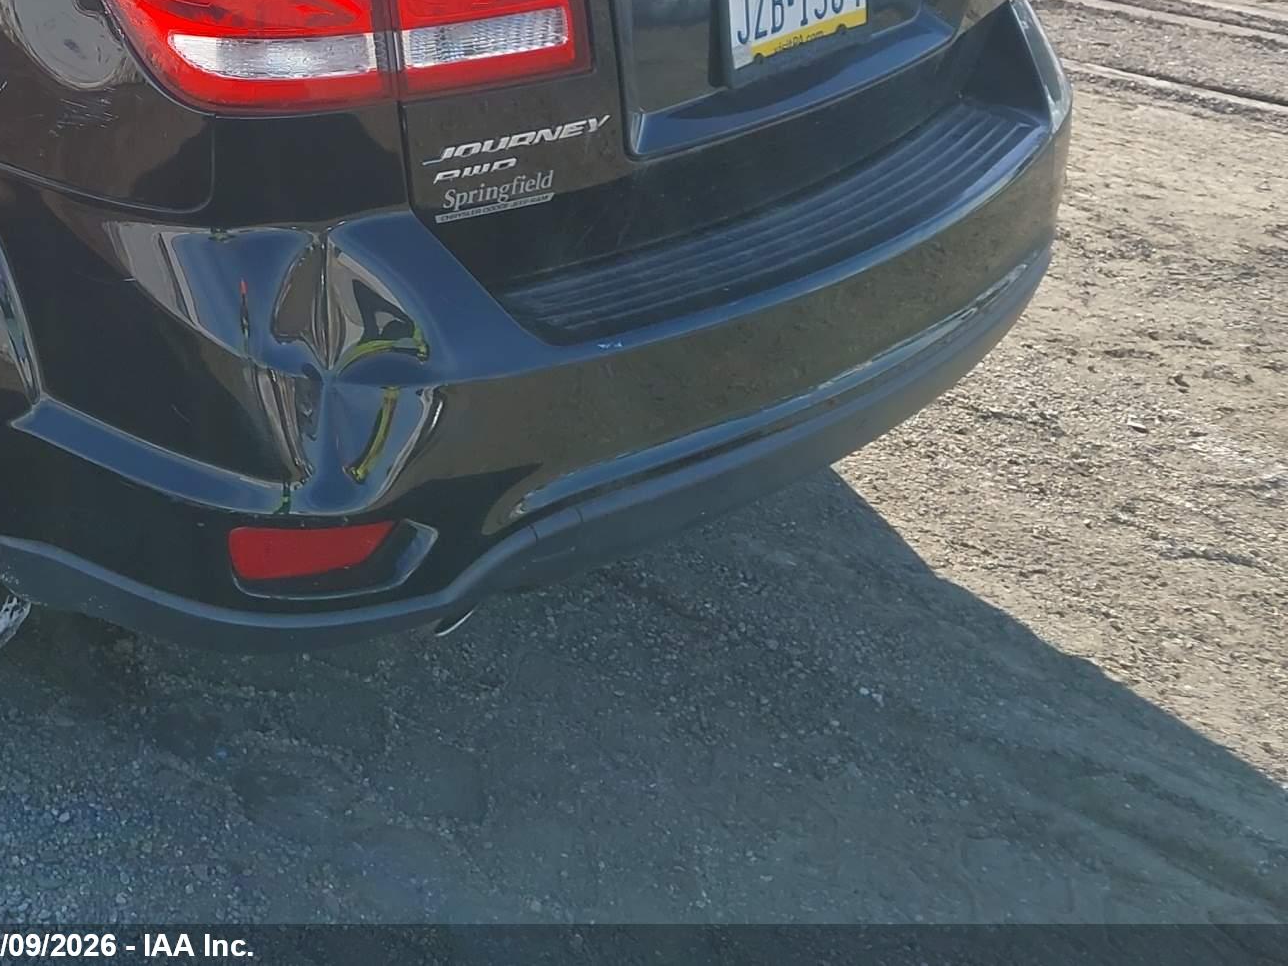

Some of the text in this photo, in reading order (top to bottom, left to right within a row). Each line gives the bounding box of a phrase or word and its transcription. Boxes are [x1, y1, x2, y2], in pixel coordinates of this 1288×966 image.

[421, 114, 611, 166] JOURNEY
[433, 157, 518, 184] AWD
[442, 169, 555, 212] Springfield
